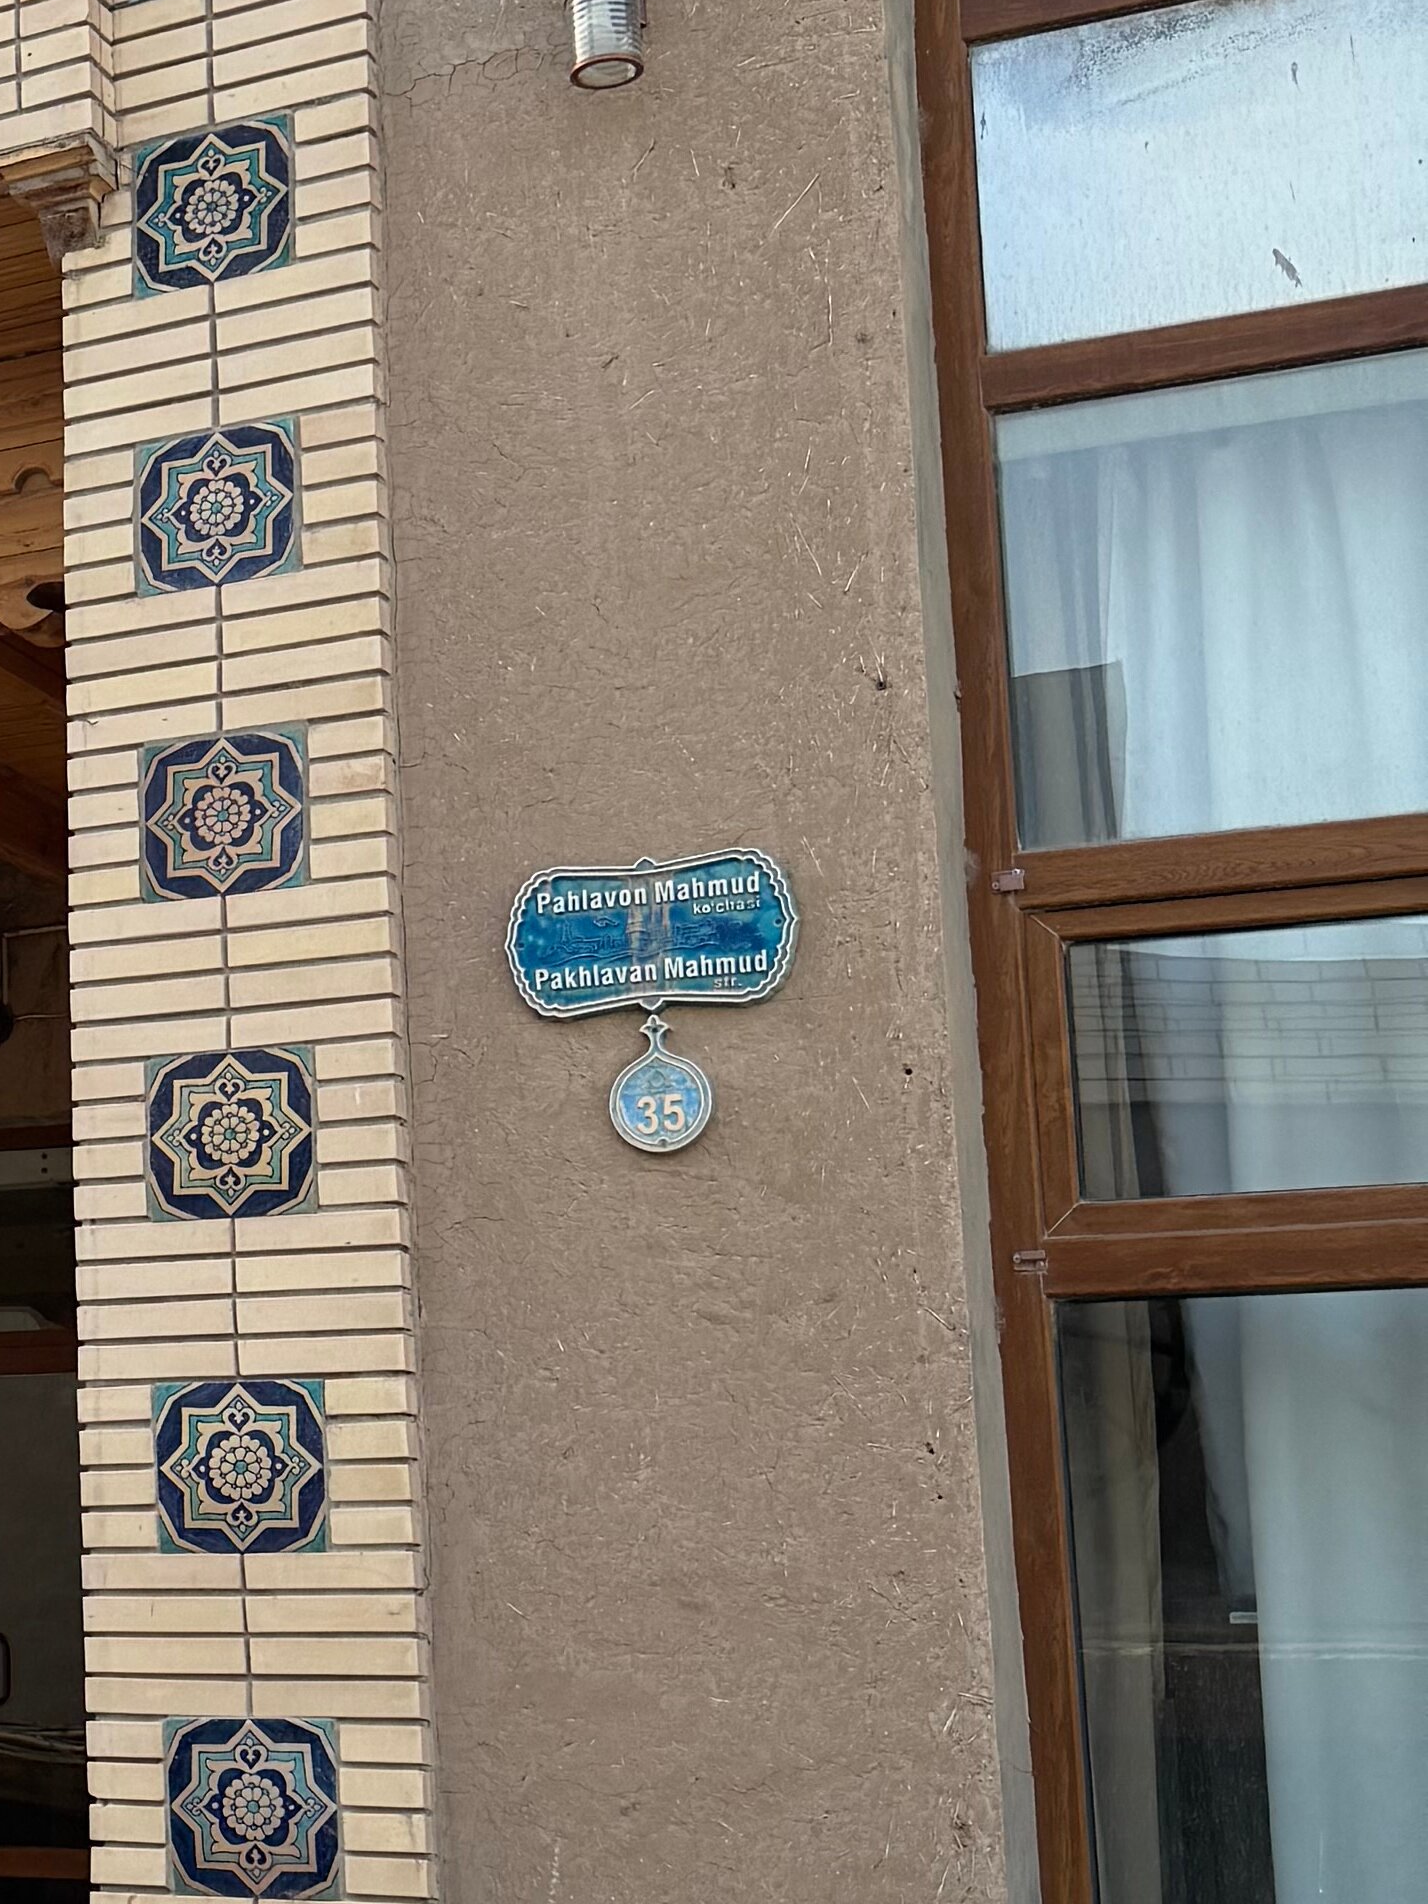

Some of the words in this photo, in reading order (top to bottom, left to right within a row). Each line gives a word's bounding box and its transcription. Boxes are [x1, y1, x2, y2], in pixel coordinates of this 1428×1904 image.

[537, 882, 647, 914] Pahlavon
[654, 871, 761, 903] Mahmud
[535, 961, 657, 992] Pakhlavan
[664, 949, 768, 979] Mahmud
[635, 1093, 686, 1135] 35
